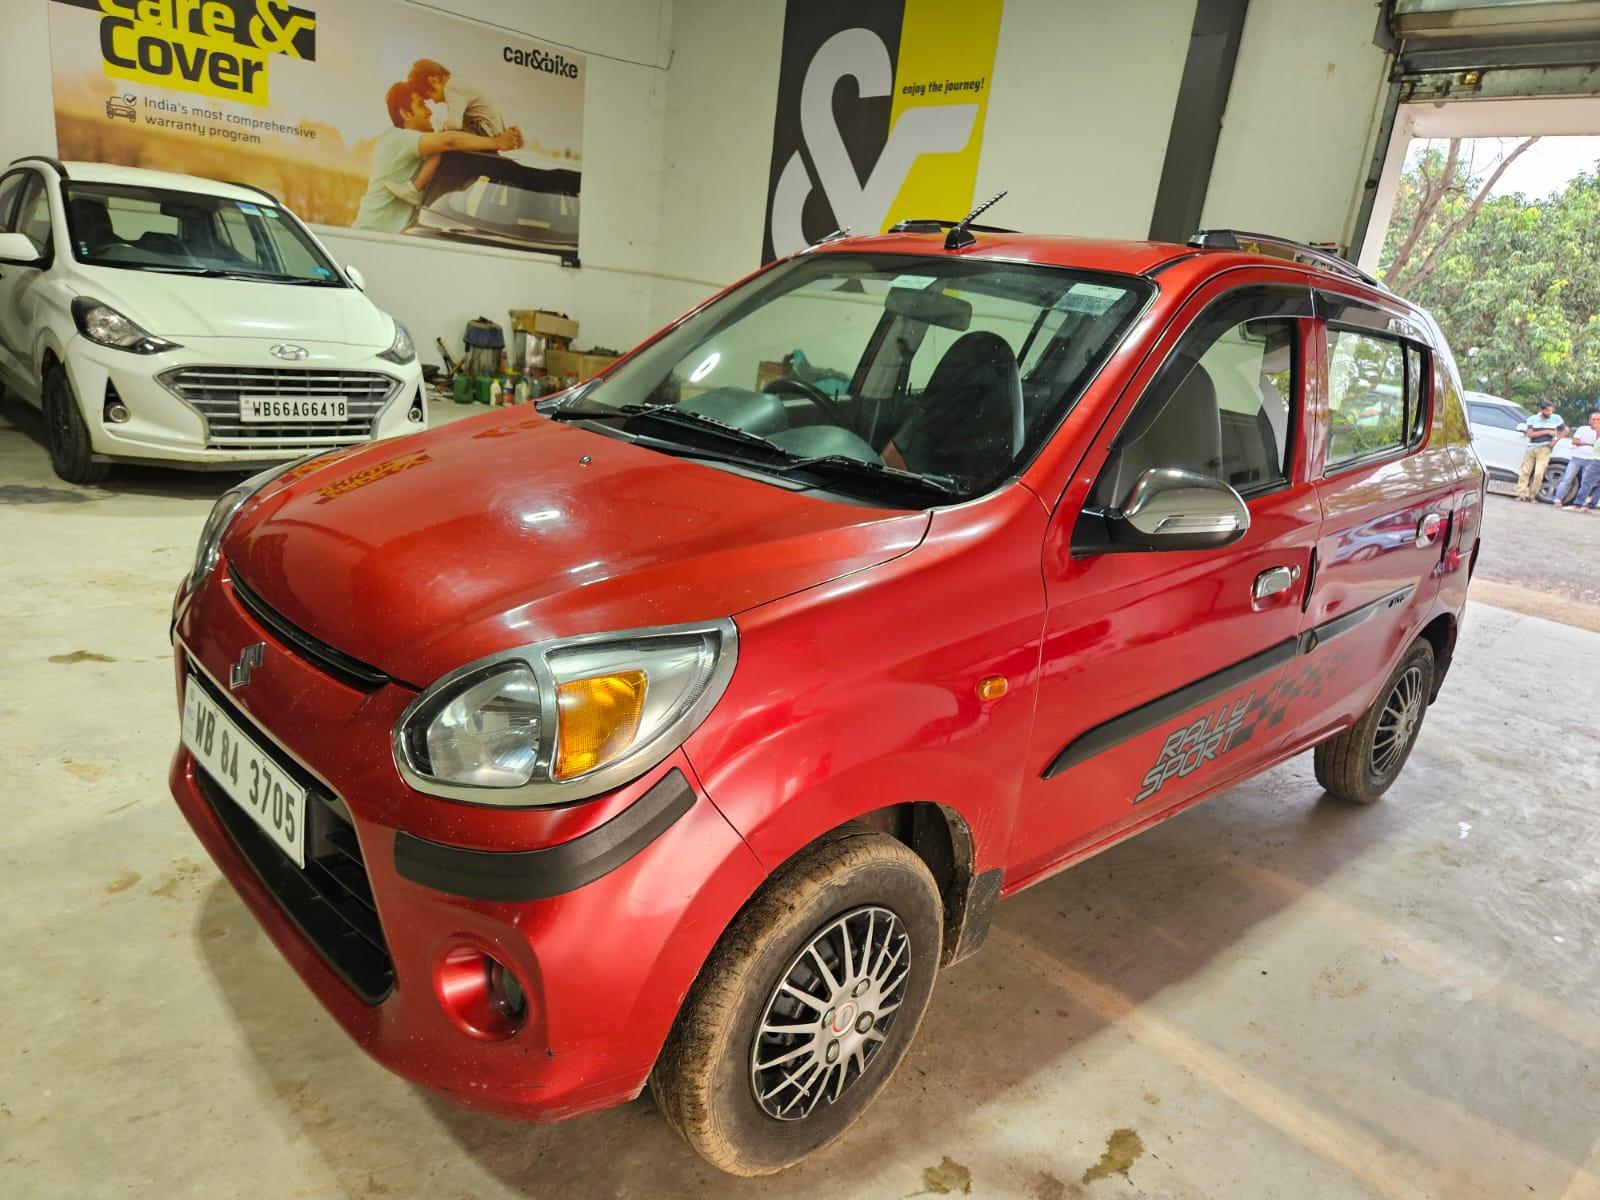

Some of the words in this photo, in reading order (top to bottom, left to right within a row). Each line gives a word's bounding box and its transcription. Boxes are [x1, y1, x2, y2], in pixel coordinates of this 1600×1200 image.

[100, 15, 263, 93] Cover
[249, 0, 316, 59] &
[503, 46, 578, 79] car&bike
[902, 82, 926, 96] enjoy
[928, 80, 943, 93] the
[944, 77, 985, 95] journey!
[144, 96, 189, 115] India's
[192, 106, 223, 121] most
[227, 112, 318, 140] comprehensive
[145, 114, 206, 137] warranty
[209, 125, 262, 144] program
[253, 401, 346, 417] WB66AG6418
[1155, 688, 1257, 767] RALLY
[194, 701, 216, 758] WB
[220, 729, 239, 787] 84
[248, 758, 296, 844] 3705
[1132, 718, 1244, 806] SPORT
